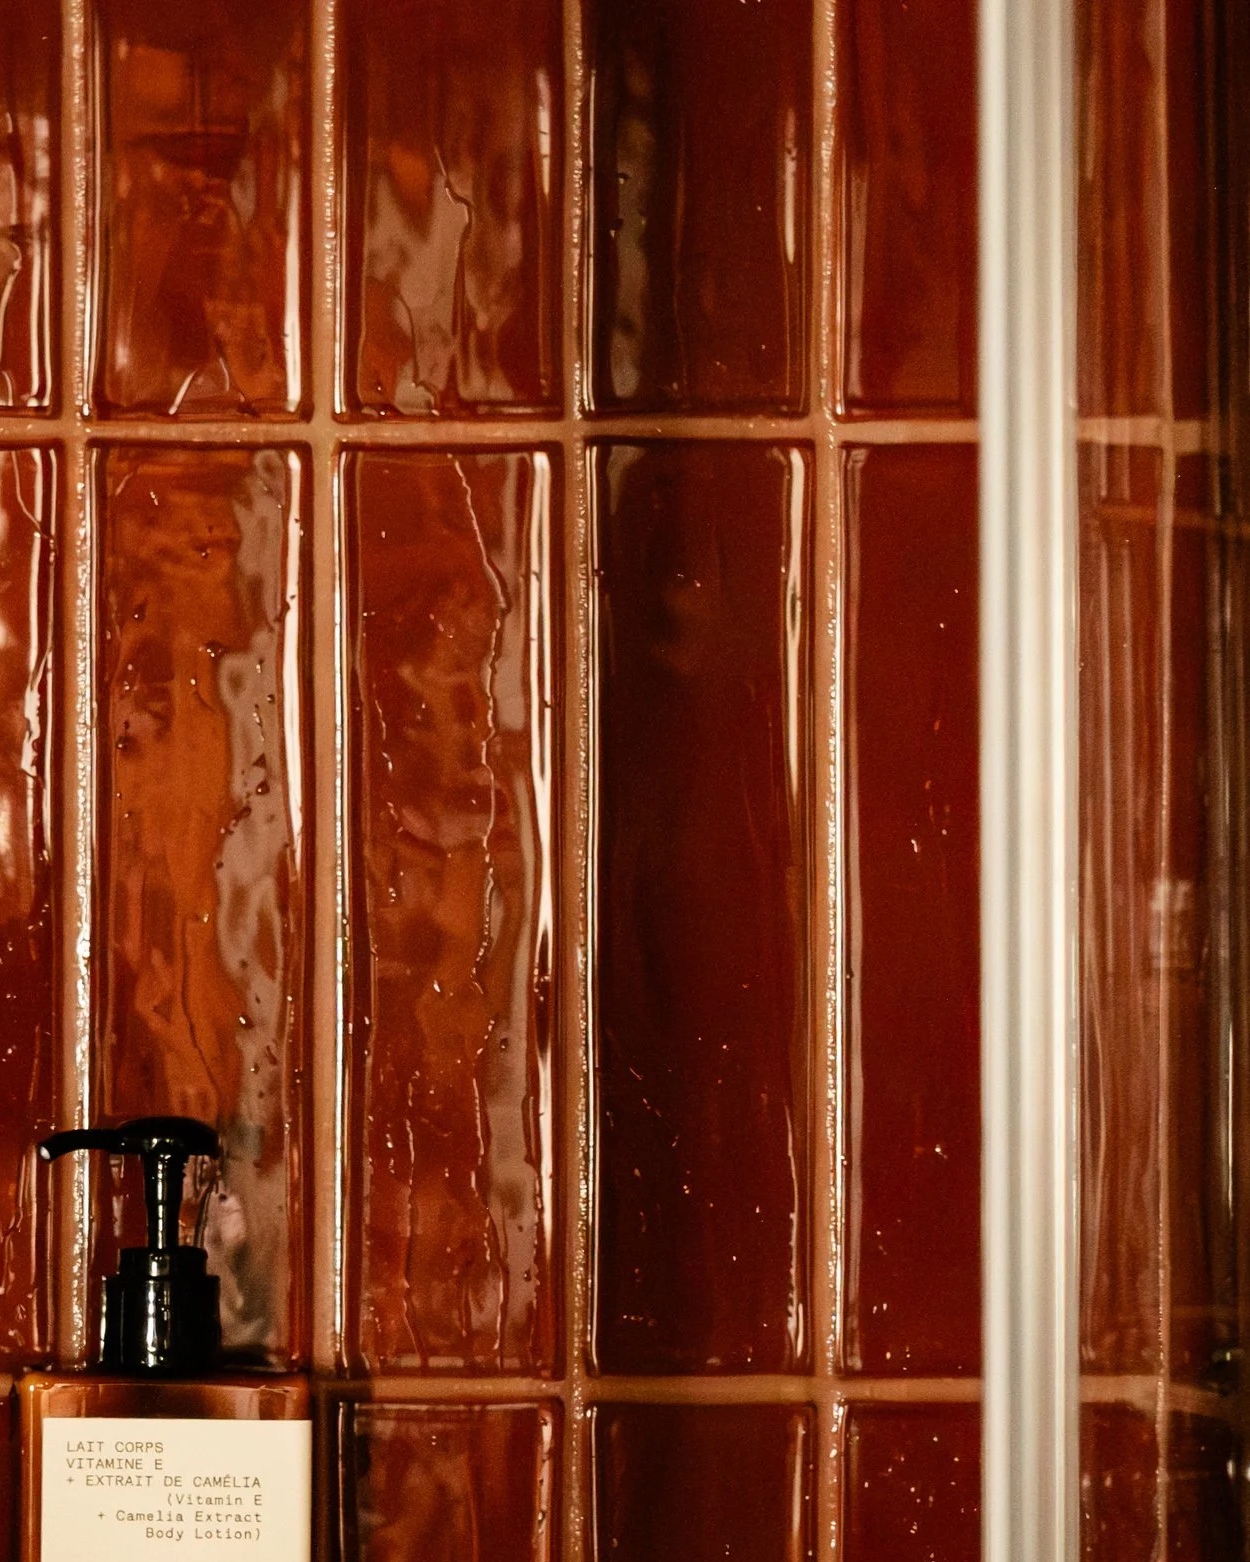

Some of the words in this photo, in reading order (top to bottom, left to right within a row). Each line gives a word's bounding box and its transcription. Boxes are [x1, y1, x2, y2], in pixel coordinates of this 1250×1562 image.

[66, 1440, 105, 1453] LAIT
[114, 1441, 164, 1454] CORPS
[65, 1457, 143, 1470] VITAMINE
[154, 1458, 163, 1471] E
[85, 1474, 154, 1487] EXTRAIT
[163, 1475, 183, 1488] DE
[192, 1474, 261, 1489] CAMÉLIA
[166, 1493, 243, 1506] (Vitamin
[253, 1494, 263, 1506] E
[115, 1509, 184, 1522] Camelia
[194, 1510, 262, 1523] Extract
[145, 1526, 184, 1542] Body
[194, 1527, 261, 1541] Lotion)
